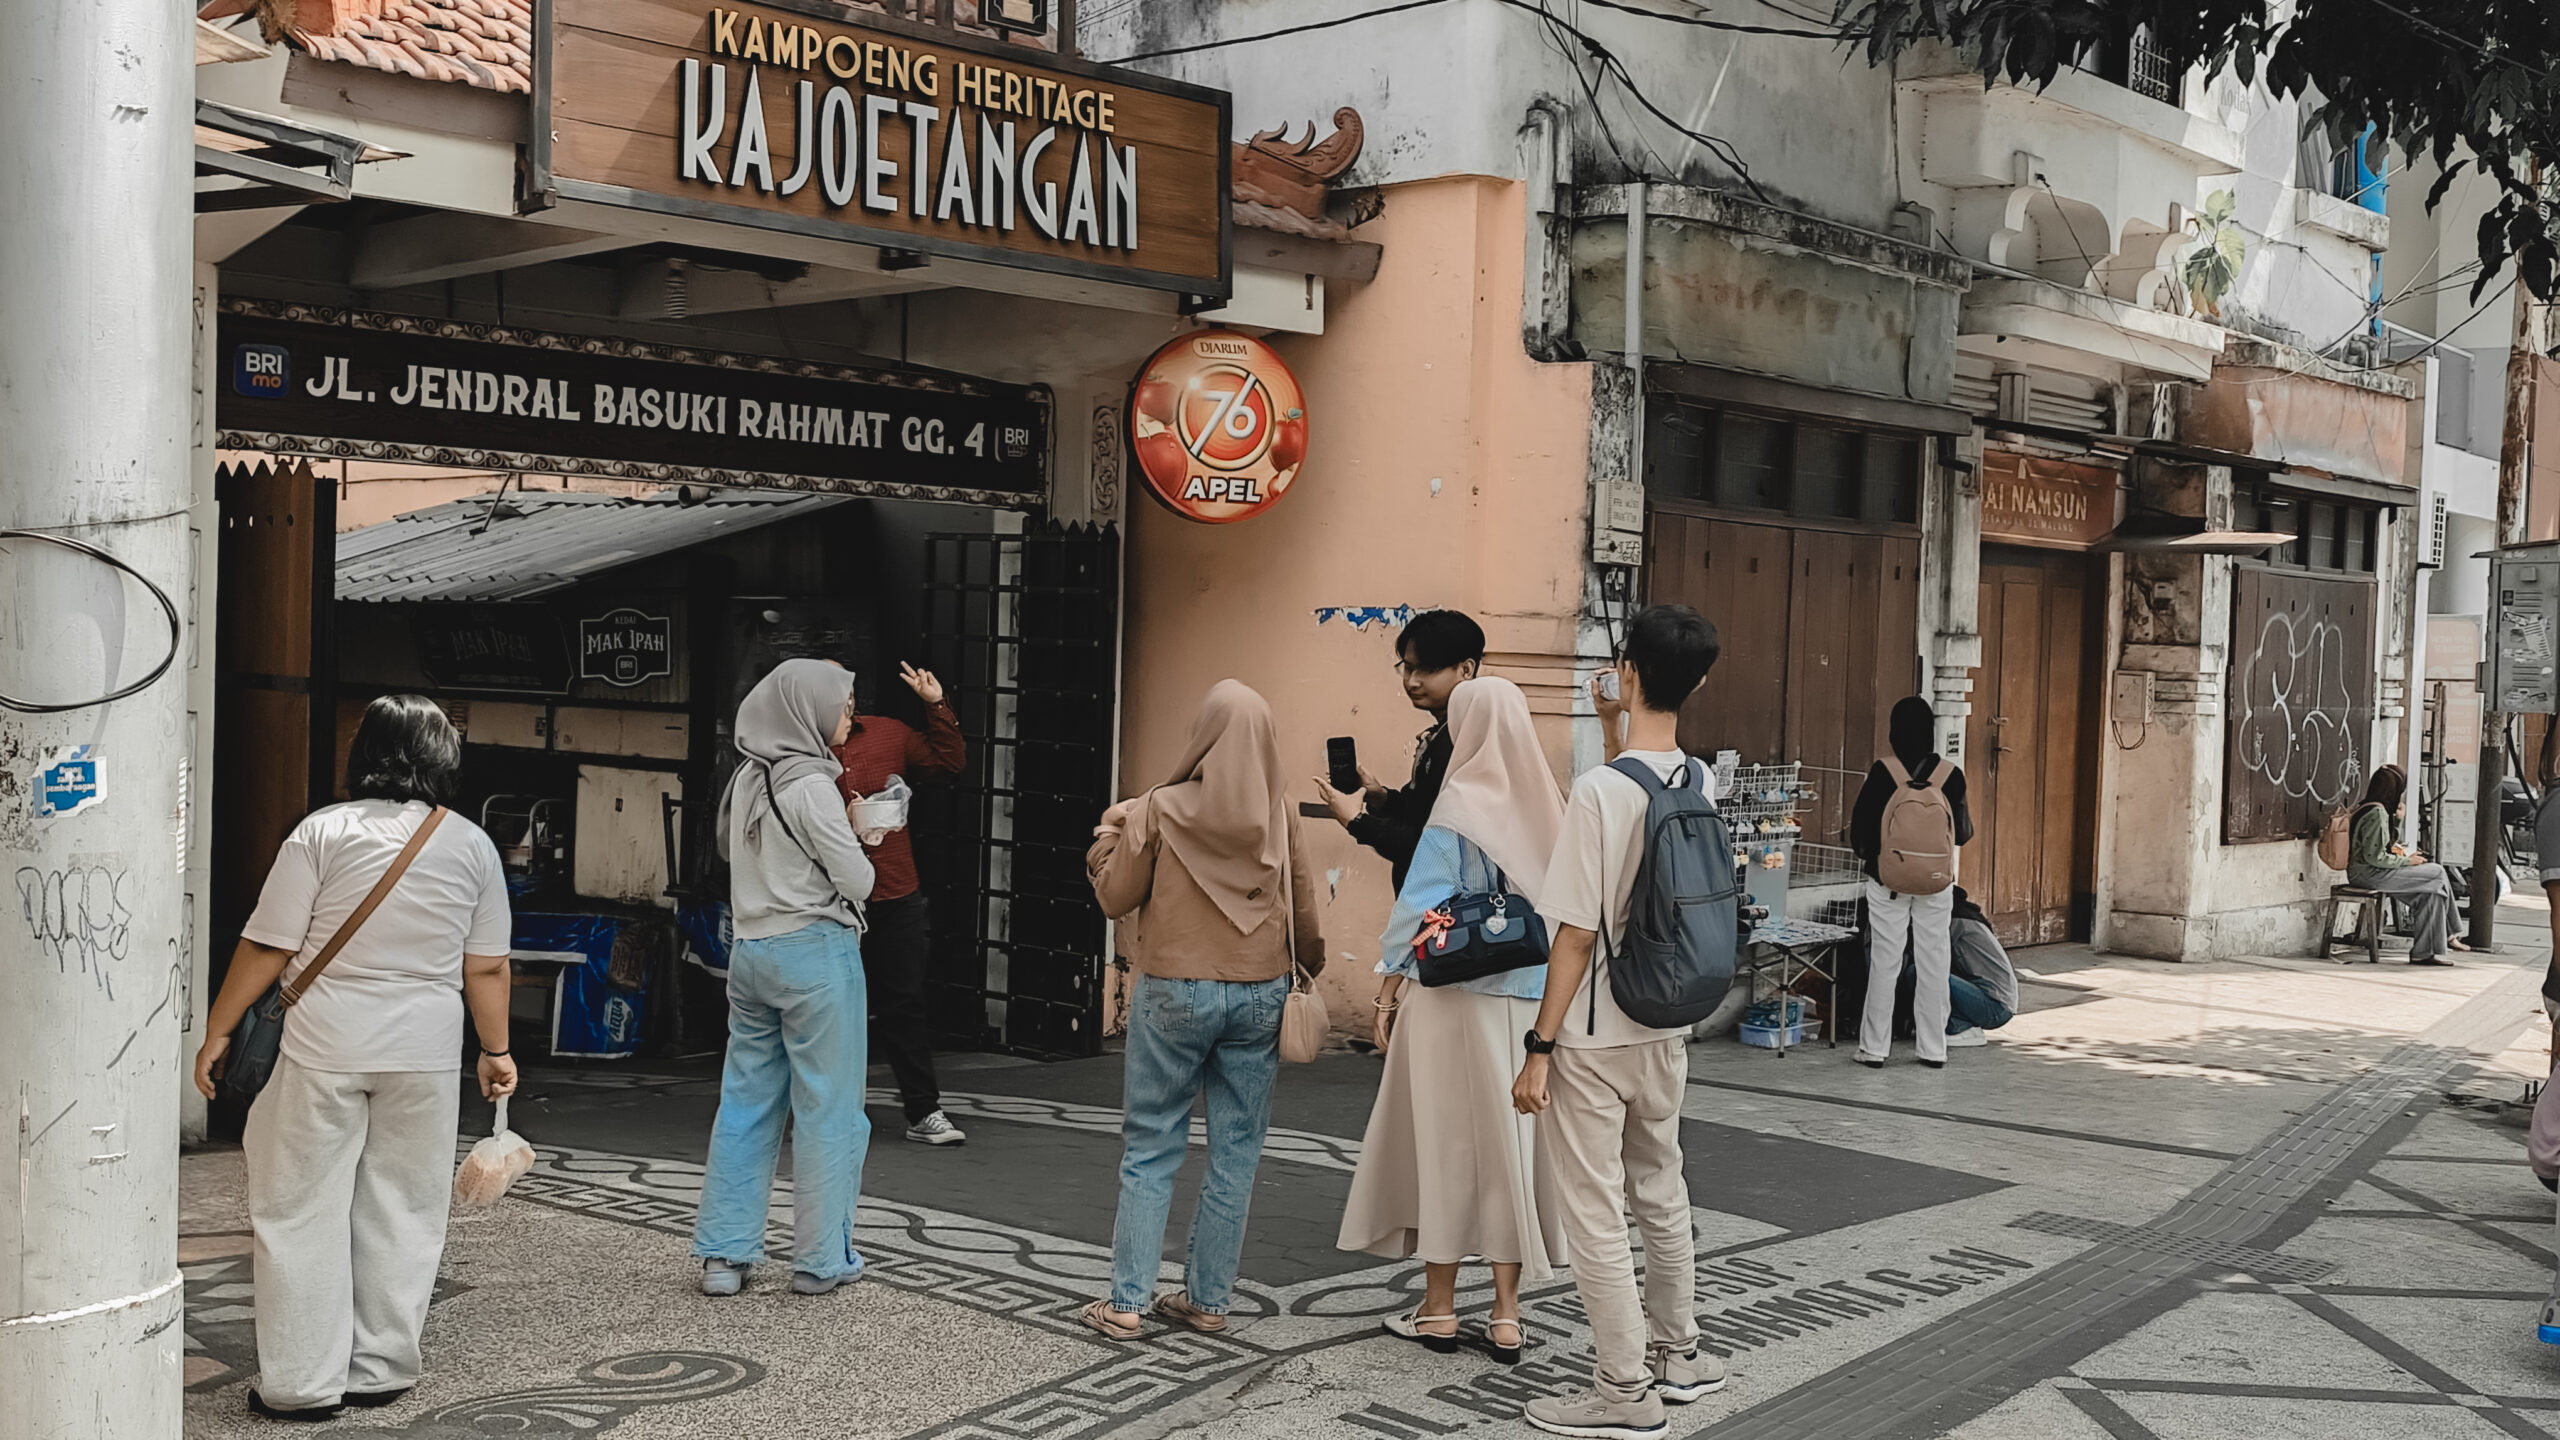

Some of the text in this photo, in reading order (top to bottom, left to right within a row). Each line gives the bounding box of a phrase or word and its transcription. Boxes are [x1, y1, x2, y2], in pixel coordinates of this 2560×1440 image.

[713, 11, 1116, 134] KAMPOENG HERITAGE
[680, 57, 1138, 251] KAJOETANGAN
[1199, 341, 1248, 356] DJARUM
[245, 351, 283, 375] BRI
[252, 374, 282, 389] mo
[305, 356, 985, 457] JL. JENDRAL BASUKI RAHMAT GG. 4
[1187, 372, 1257, 459] 76
[1004, 427, 1029, 446] BRI
[1183, 475, 1262, 504] APEL
[2011, 485, 2087, 521] NAMSUN
[614, 616, 637, 625] KEDAI
[586, 629, 664, 655] MAK IPAH
